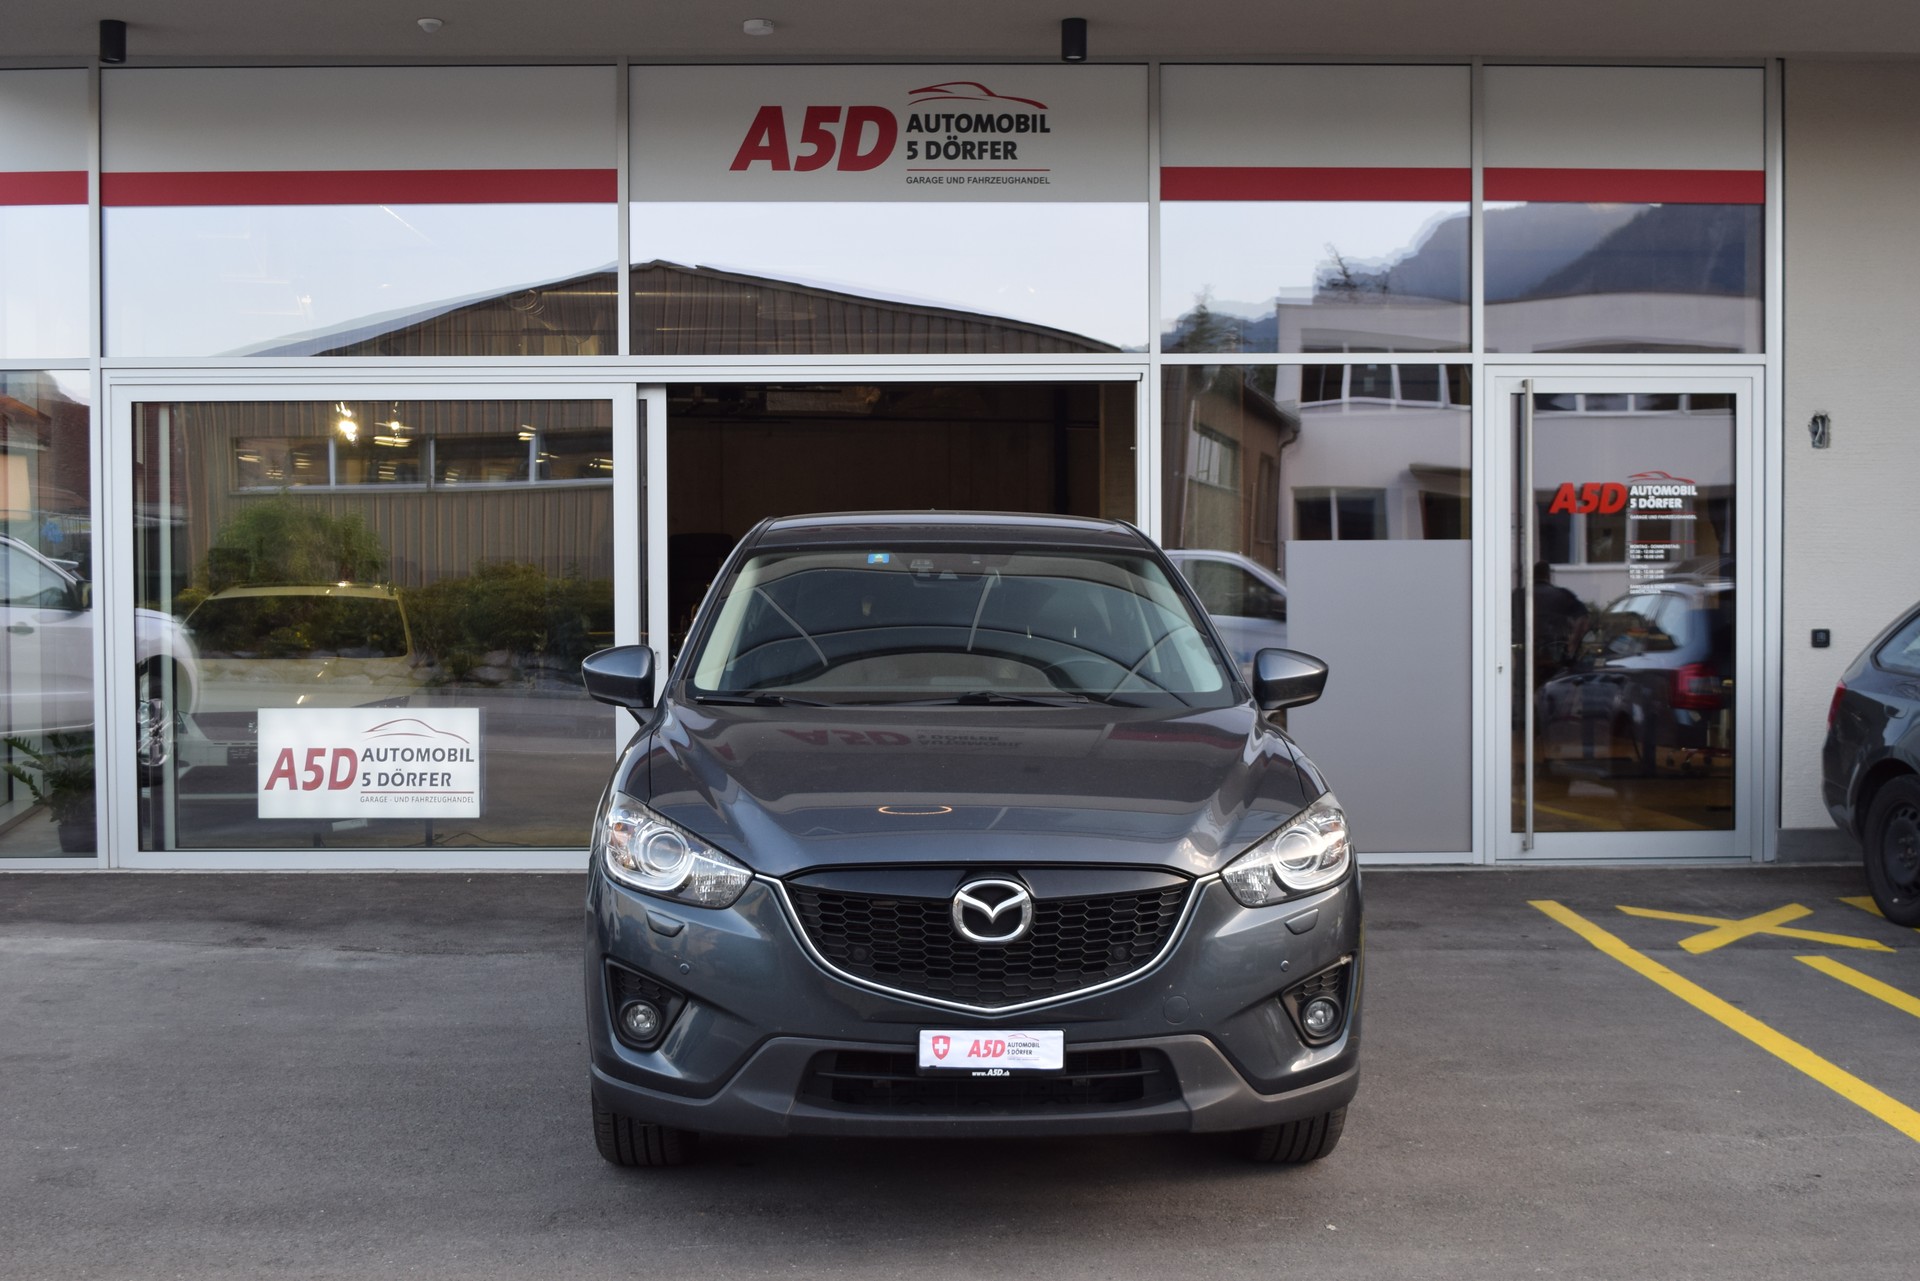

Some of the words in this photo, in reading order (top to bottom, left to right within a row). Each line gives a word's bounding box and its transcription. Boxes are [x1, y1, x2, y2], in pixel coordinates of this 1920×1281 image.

[906, 113, 1051, 133] AUTOMOBIL
[729, 105, 898, 172] A5D
[907, 140, 918, 160] 5
[926, 135, 1018, 160] DÖRFER
[906, 176, 944, 185] GARAGE
[946, 176, 965, 185] UND
[967, 176, 1051, 185] FAHRZEUGHANDEL
[1548, 482, 1628, 514] A5D
[1630, 485, 1698, 496] AUTOMOBIL
[1630, 498, 1637, 508] 5
[1639, 495, 1682, 508] DÖRFER
[361, 747, 475, 762] AUTOMOBIL
[264, 747, 358, 791] A5D
[362, 772, 371, 787] 5
[378, 769, 451, 787] DÖRFER
[967, 1039, 1006, 1058] A5D
